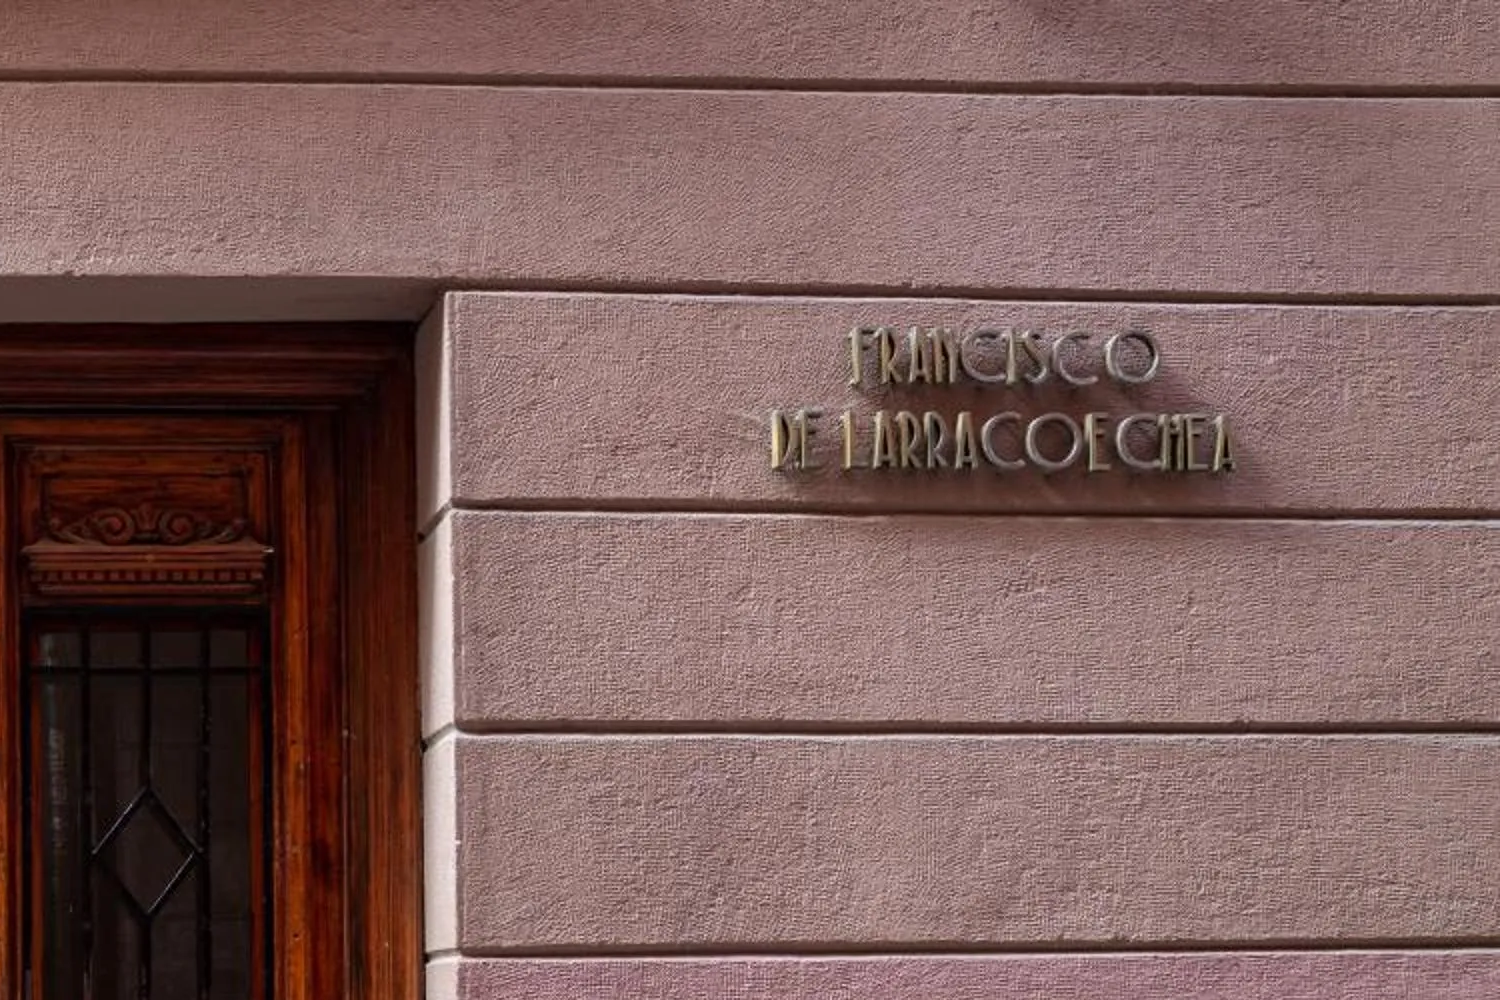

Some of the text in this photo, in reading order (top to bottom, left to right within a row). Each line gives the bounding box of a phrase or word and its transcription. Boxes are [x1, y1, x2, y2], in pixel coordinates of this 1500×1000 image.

[847, 326, 1161, 386] FRANCISCO
[770, 409, 1237, 474] DE LARRACOECHEA
